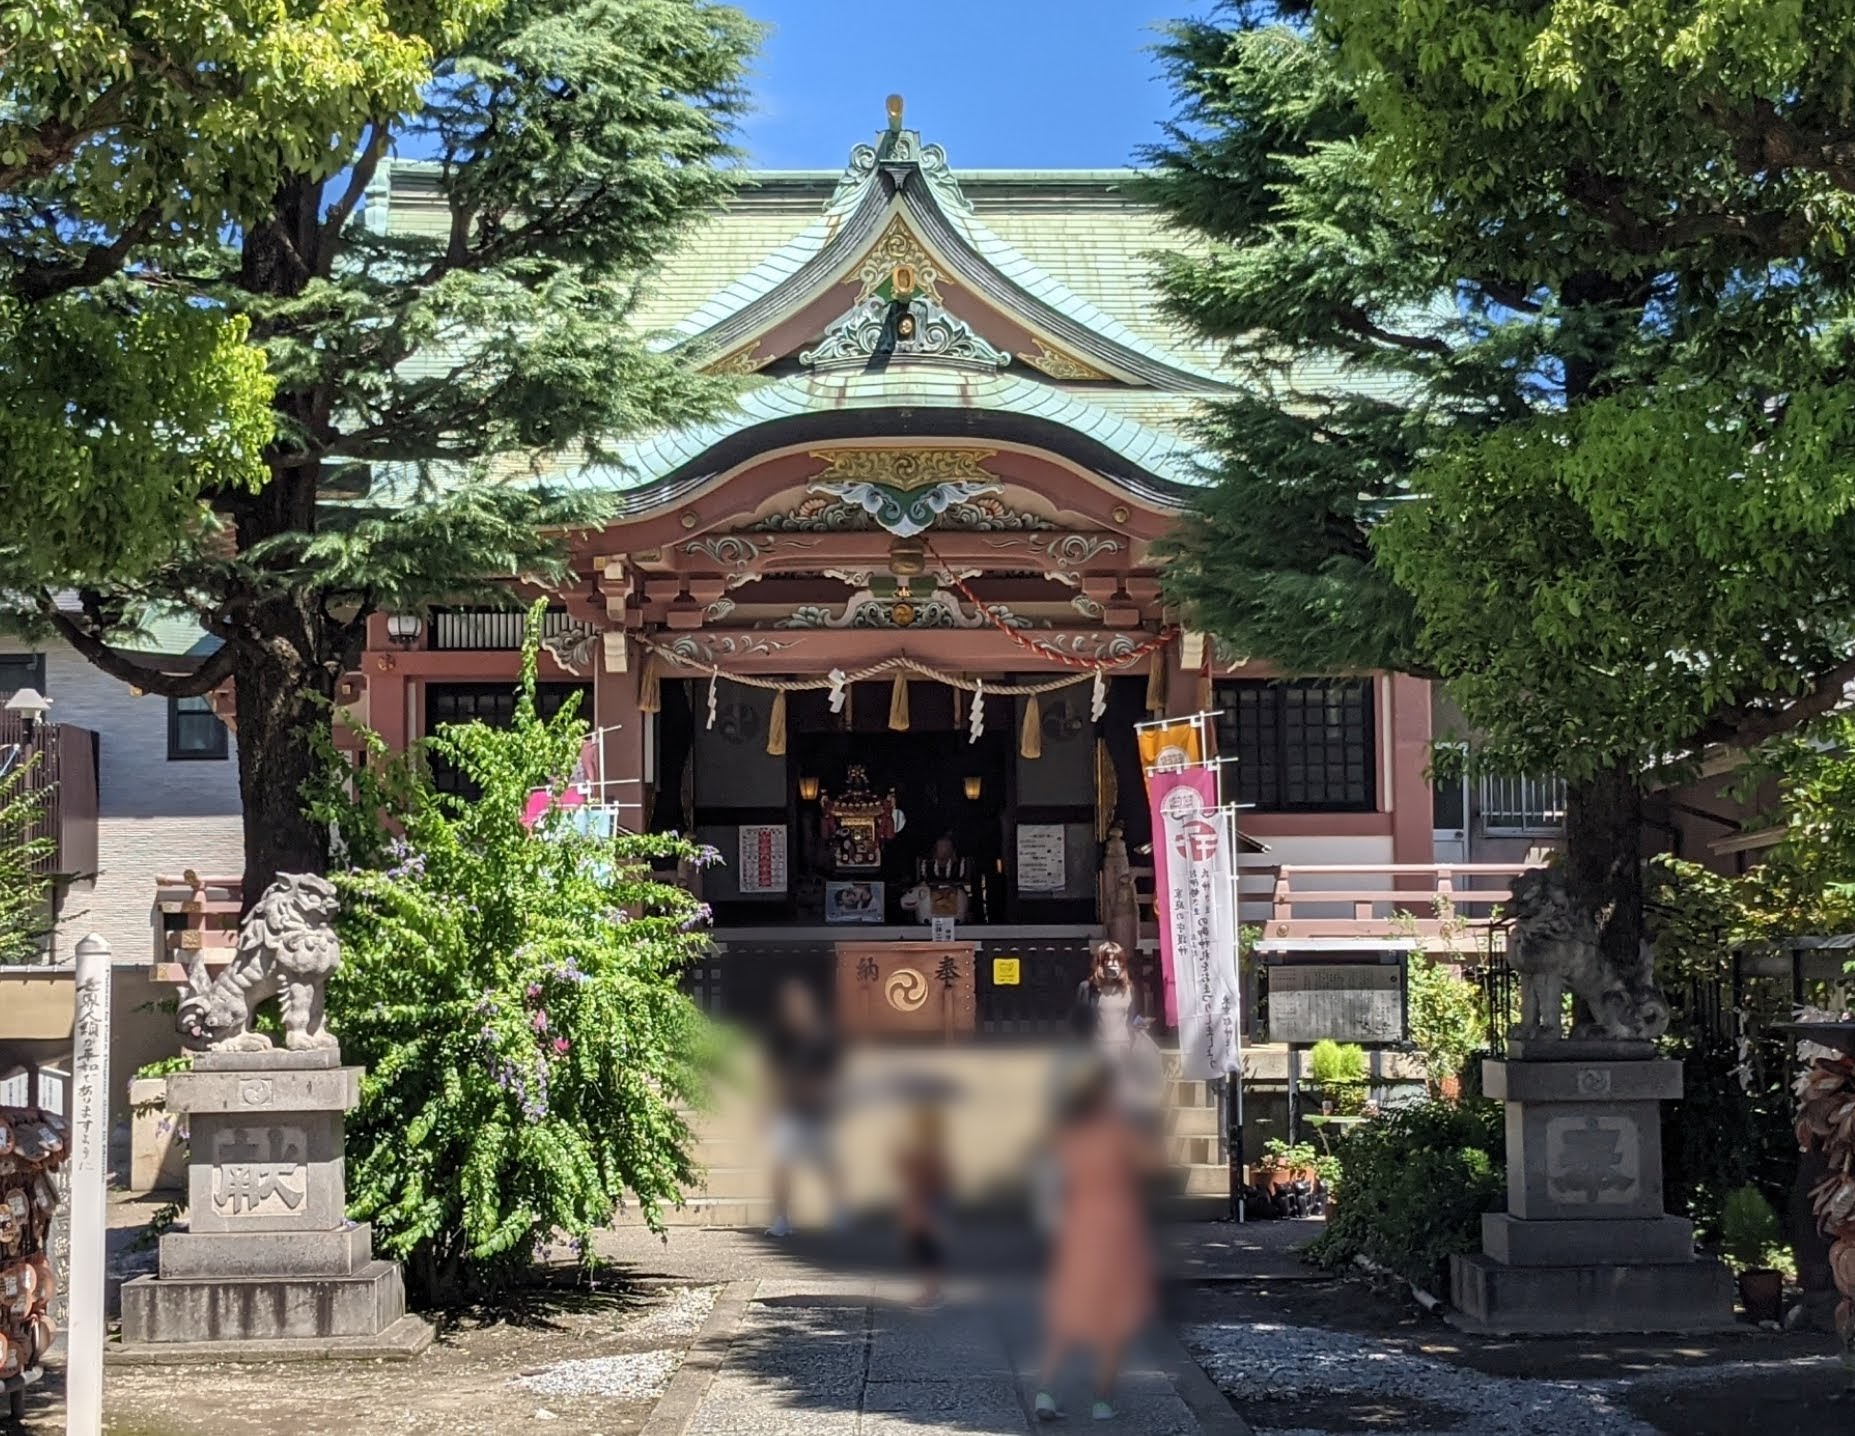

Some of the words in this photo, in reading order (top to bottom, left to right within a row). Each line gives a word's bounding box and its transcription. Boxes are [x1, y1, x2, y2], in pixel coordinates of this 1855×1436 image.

[856, 956, 880, 982] 納
[935, 955, 960, 988] 奉
[76, 977, 102, 1170] 世界人類が平和でありますように
